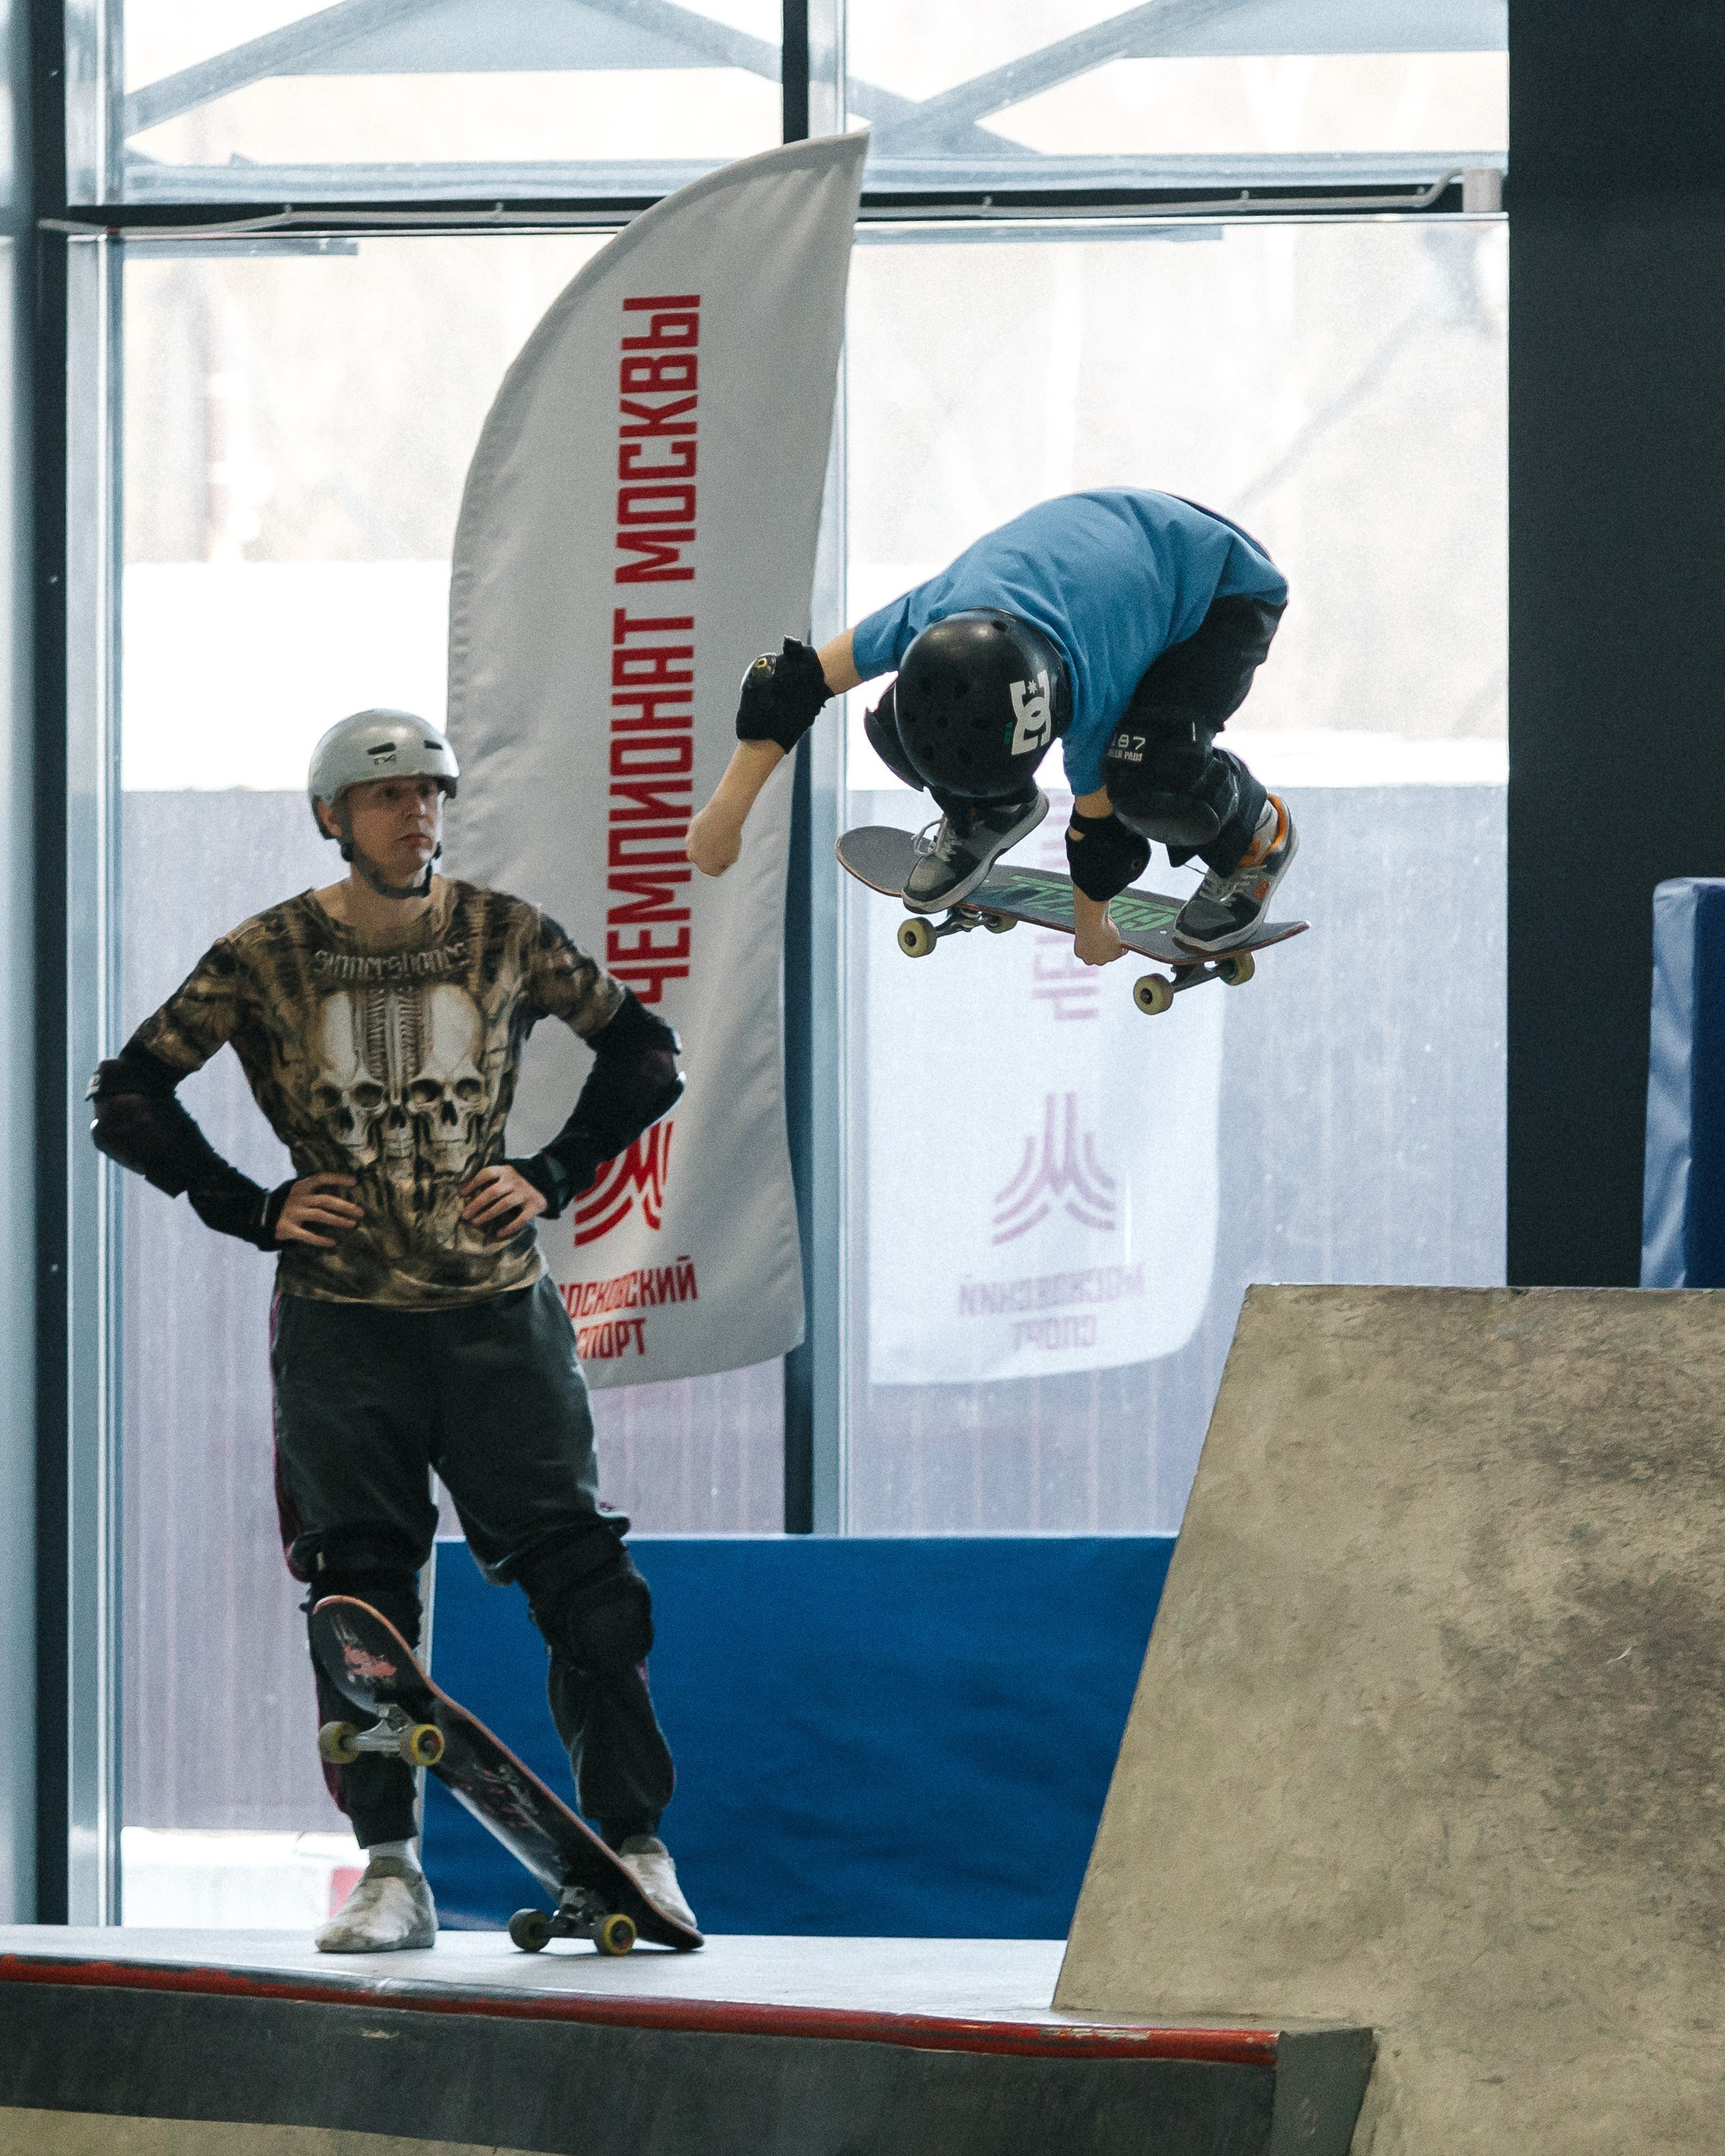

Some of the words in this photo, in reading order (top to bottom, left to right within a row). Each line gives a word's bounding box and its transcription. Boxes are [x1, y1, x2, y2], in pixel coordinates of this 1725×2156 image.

[615, 294, 701, 583] МОСКВЫ
[606, 608, 695, 1005] ЧЕМПИОНАТ
[1124, 751, 1143, 762] PADS
[559, 1255, 698, 1318] ОСКОВСКИЙ
